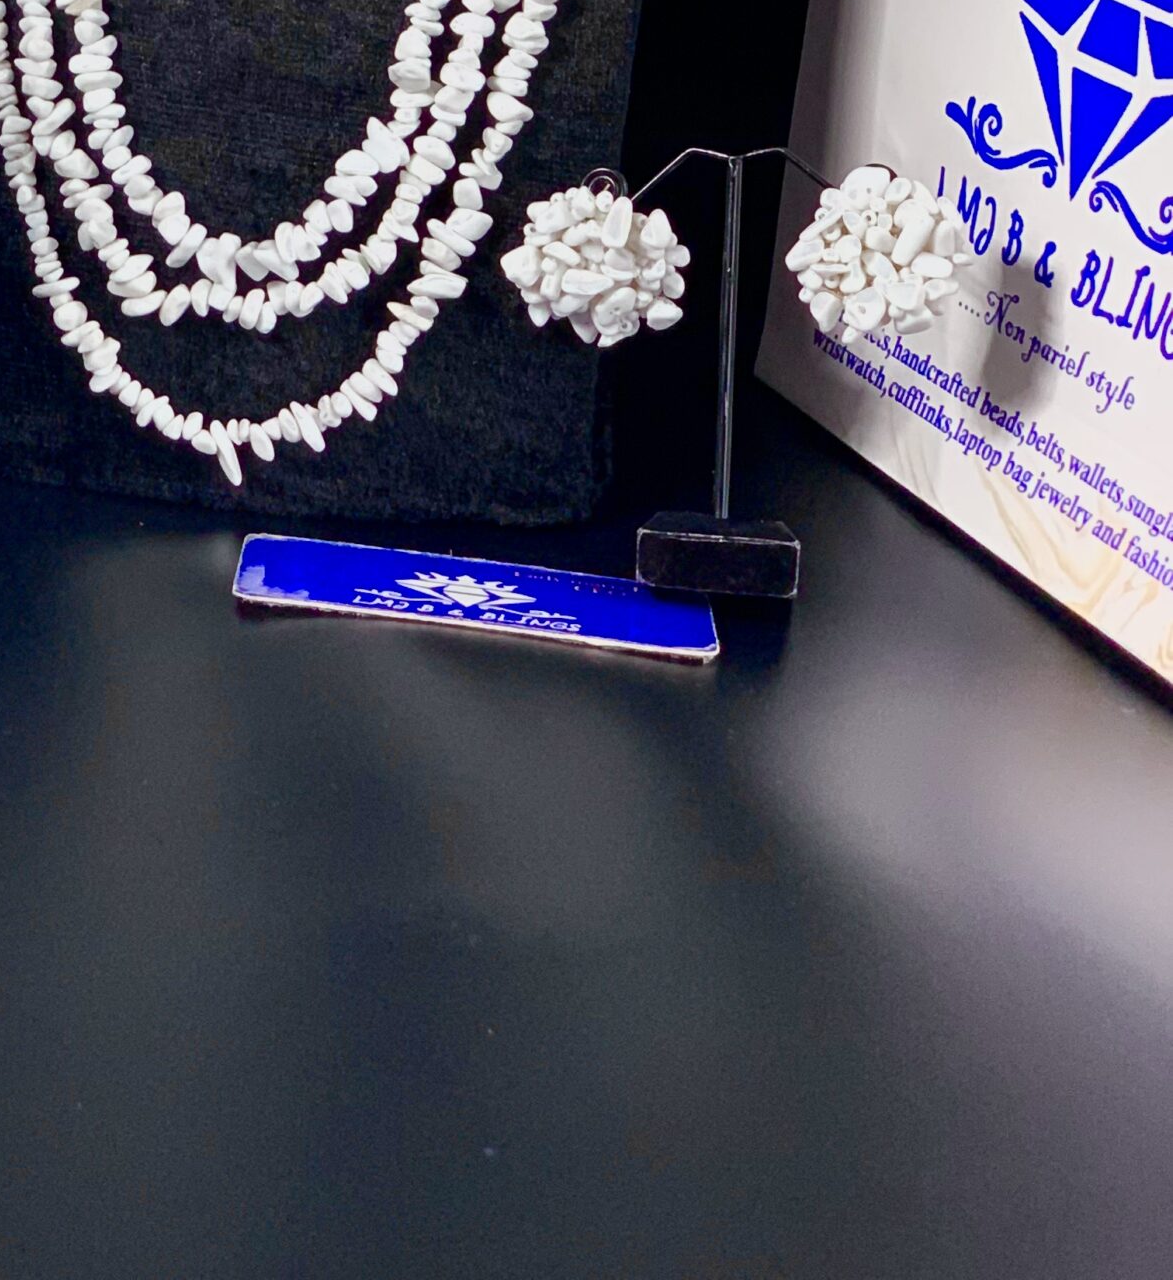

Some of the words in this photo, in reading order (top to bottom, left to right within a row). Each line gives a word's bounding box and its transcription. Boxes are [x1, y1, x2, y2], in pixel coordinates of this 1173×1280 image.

[1001, 207, 1024, 267] B
[1034, 240, 1058, 290] &
[1020, 335, 1091, 379] pariel
[1085, 376, 1136, 415] style
[1002, 451, 1034, 494] bag
[1027, 471, 1094, 533] jewelry
[1091, 519, 1128, 552] and
[1122, 535, 1173, 591] fashio
[417, 602, 435, 614] B
[478, 611, 582, 633] BLINGS
